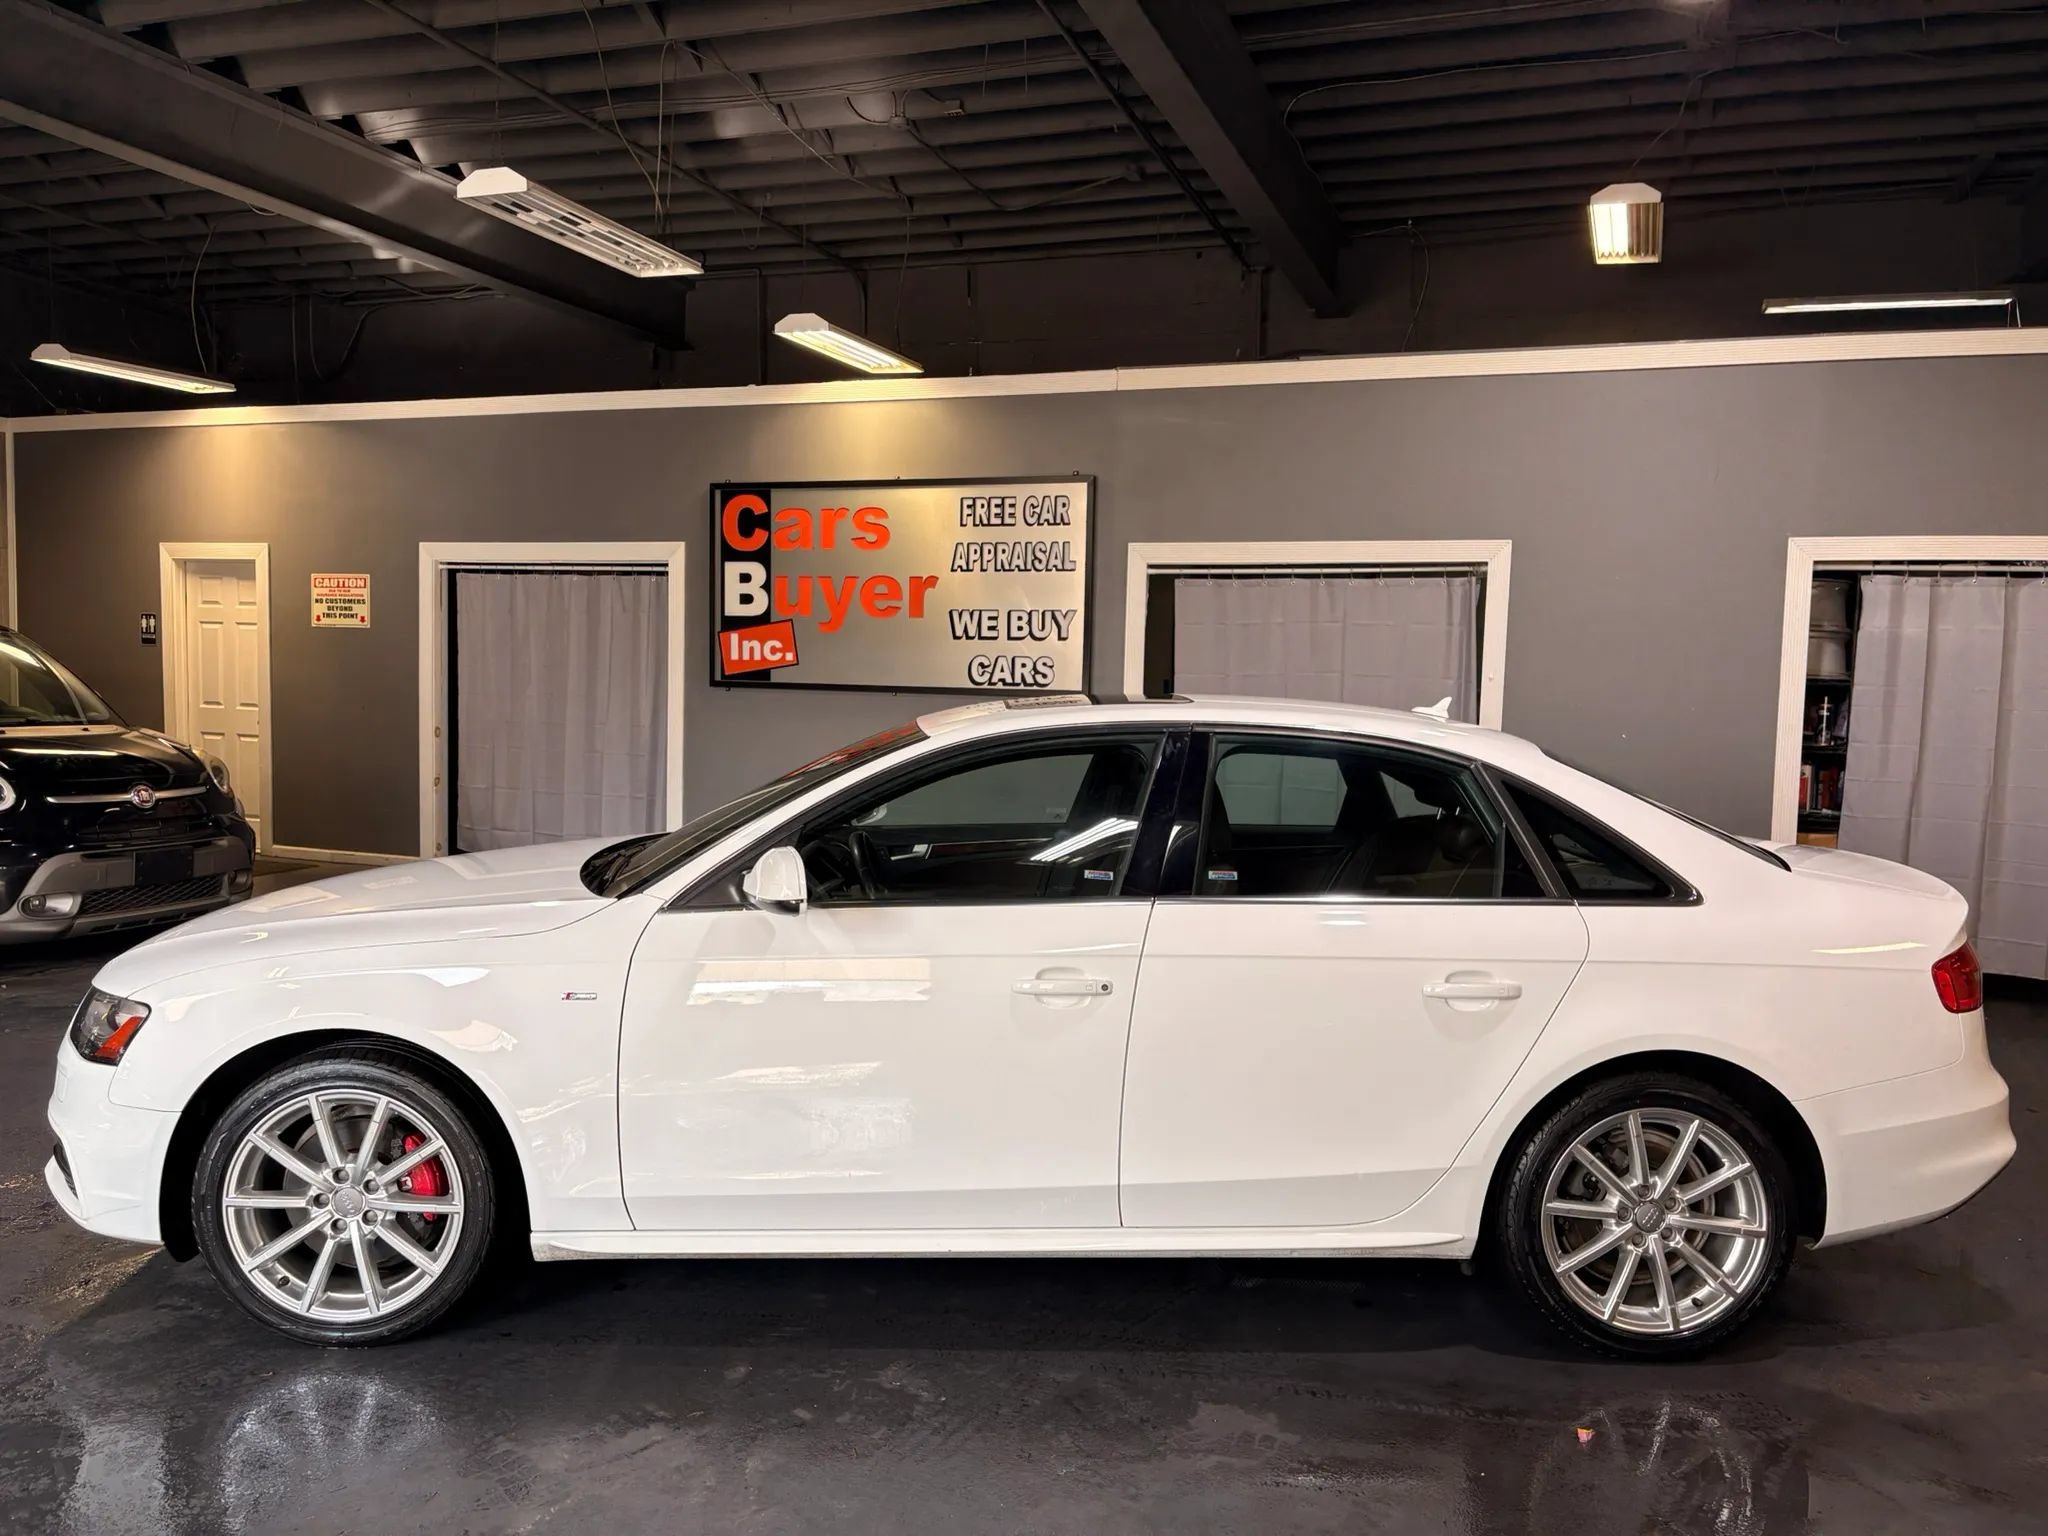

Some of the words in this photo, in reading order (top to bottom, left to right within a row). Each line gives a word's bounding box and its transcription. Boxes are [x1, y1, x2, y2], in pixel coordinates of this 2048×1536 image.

[722, 494, 891, 551] Cars
[960, 496, 1017, 526] FREE
[1023, 495, 1071, 526] CAR
[950, 541, 1077, 572] APPRAISAL
[315, 578, 365, 587] CAUTION
[724, 561, 940, 633] Buyer
[949, 609, 1000, 640] WE
[1007, 609, 1078, 642] BUY
[729, 633, 795, 661] Inc.
[967, 654, 1055, 688] CARS
